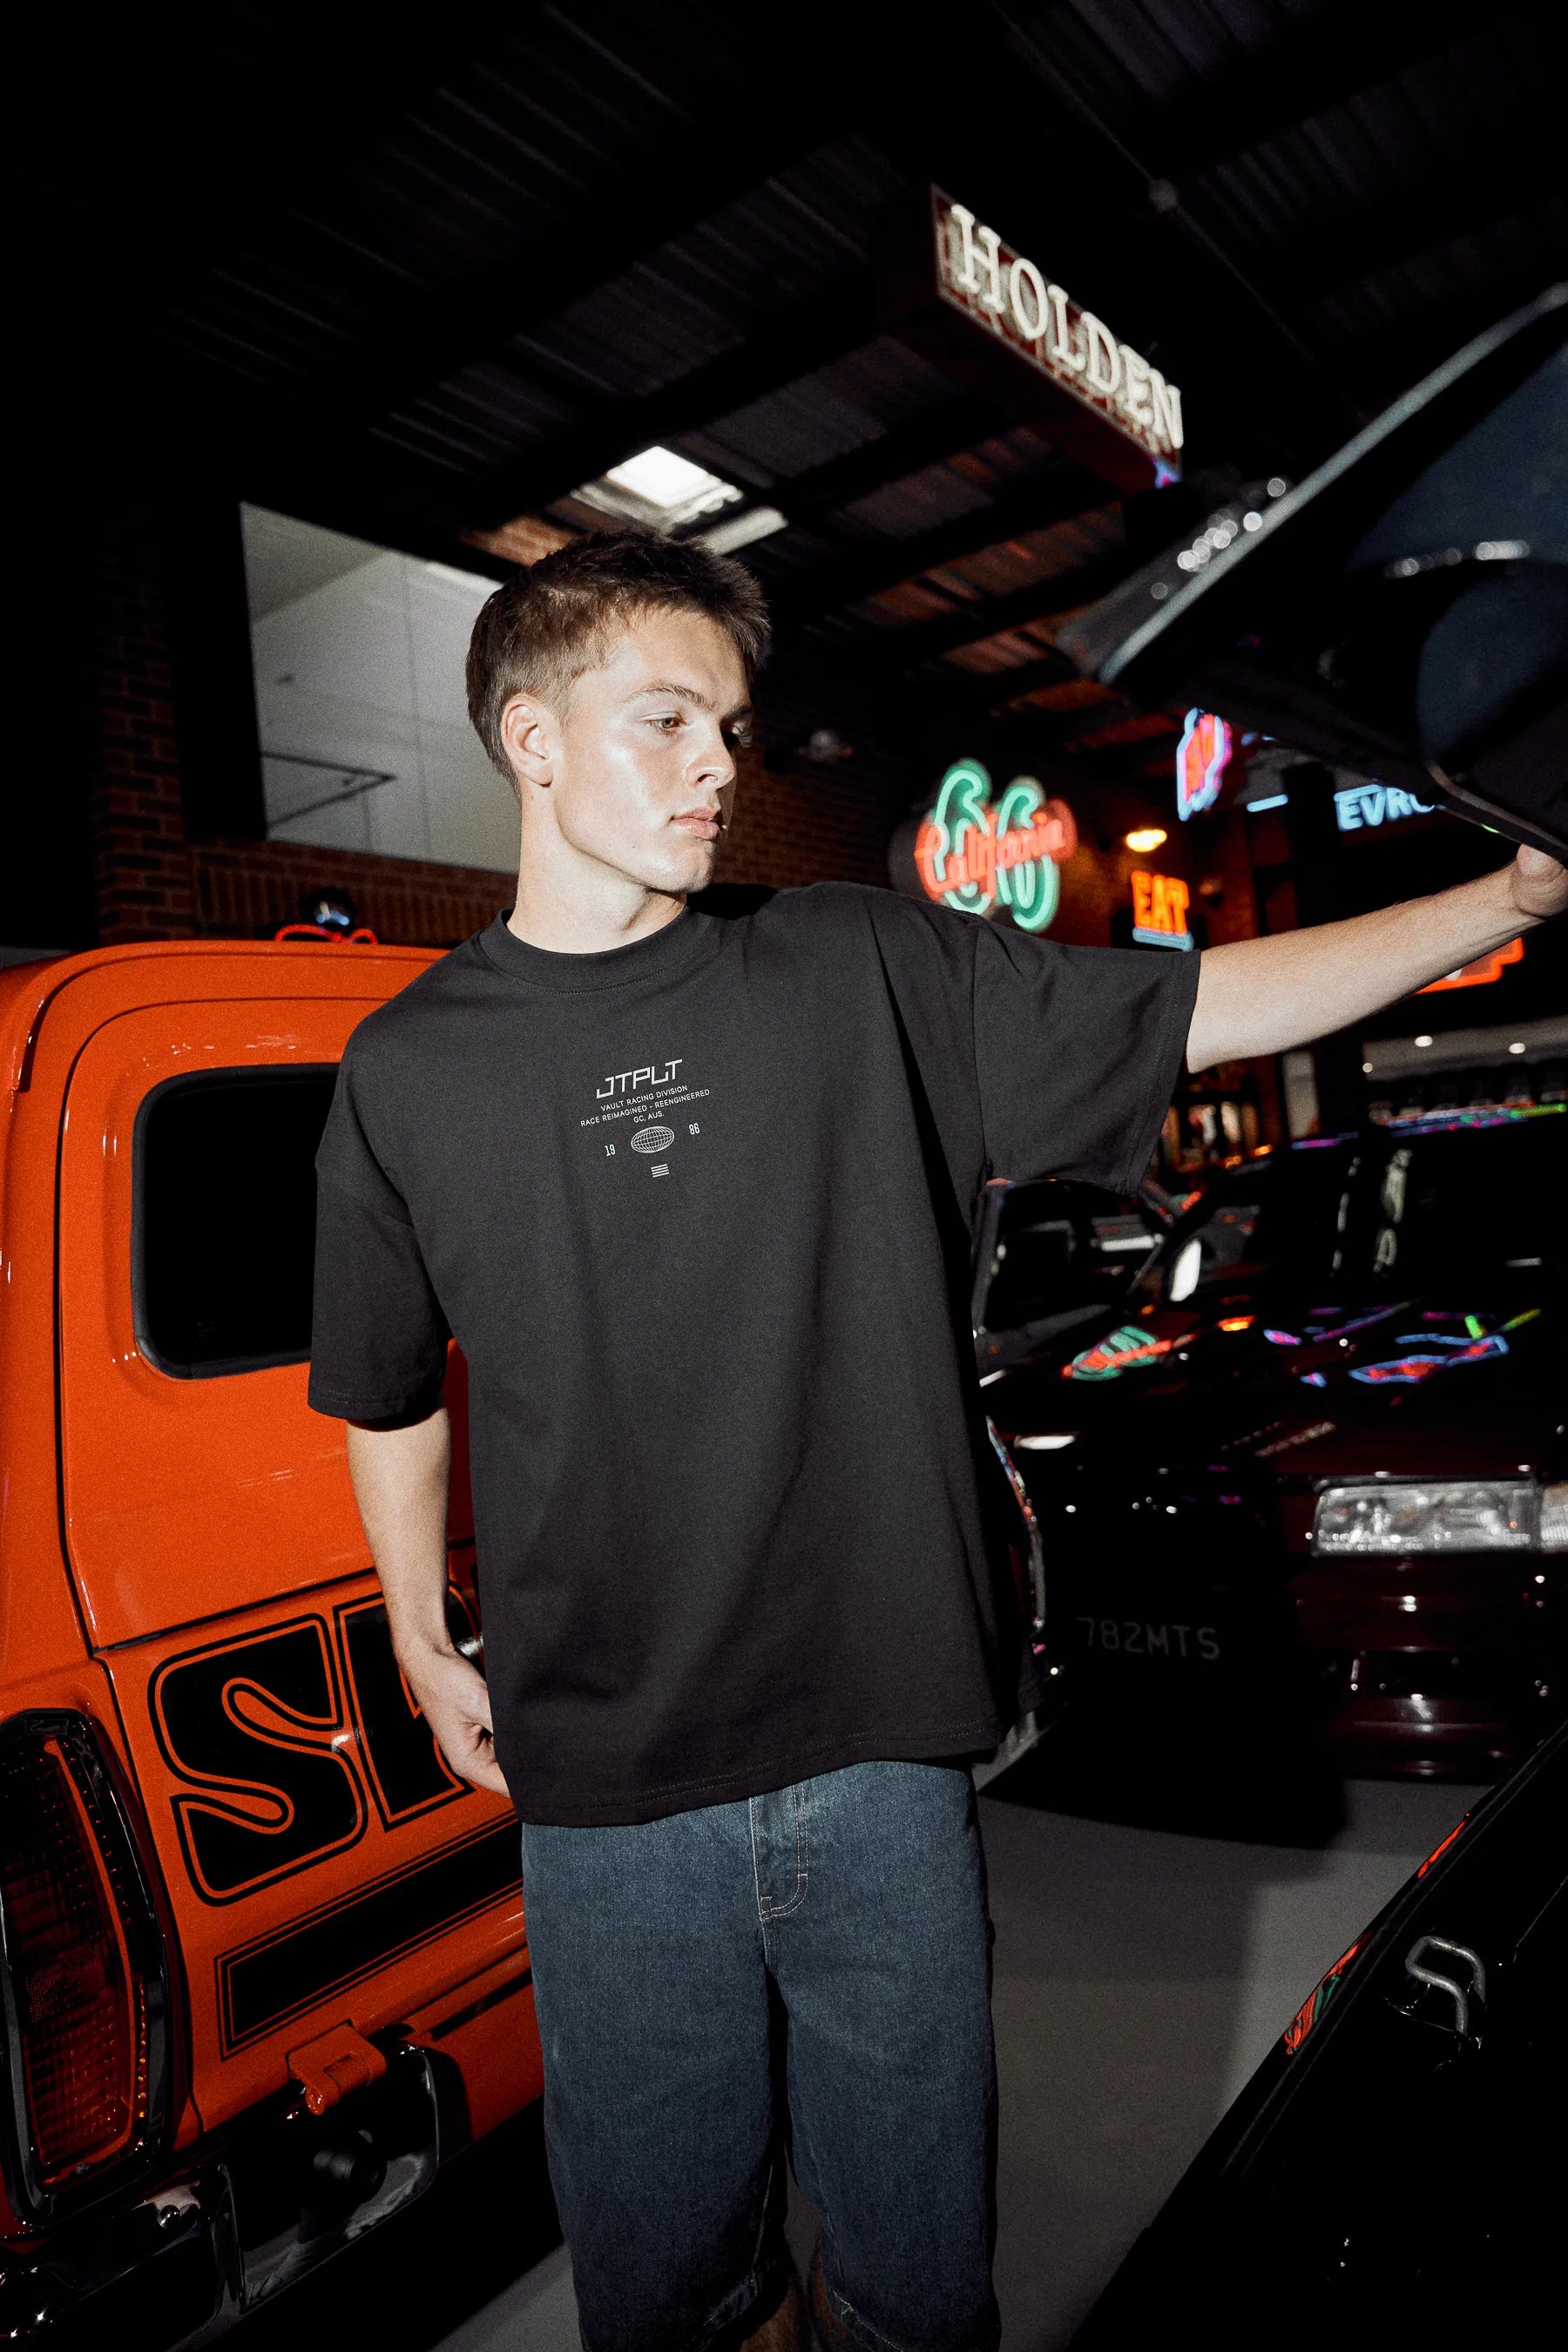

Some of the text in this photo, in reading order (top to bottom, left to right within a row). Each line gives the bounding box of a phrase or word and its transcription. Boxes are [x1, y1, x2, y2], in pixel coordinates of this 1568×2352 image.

[950, 204, 1184, 449] HOLDEN
[1131, 870, 1190, 936] EAT
[596, 1058, 683, 1099] JTPLT
[580, 1116, 600, 1127] RACE
[602, 1105, 647, 1121] REIMAGINED
[654, 1089, 710, 1109] REENGINEERED
[600, 1085, 688, 1112] VAULT RACING DIVISION
[648, 1111, 665, 1120] AUS.
[604, 1122, 700, 1157] 19 86
[1076, 1616, 1221, 1661] 782MTS
